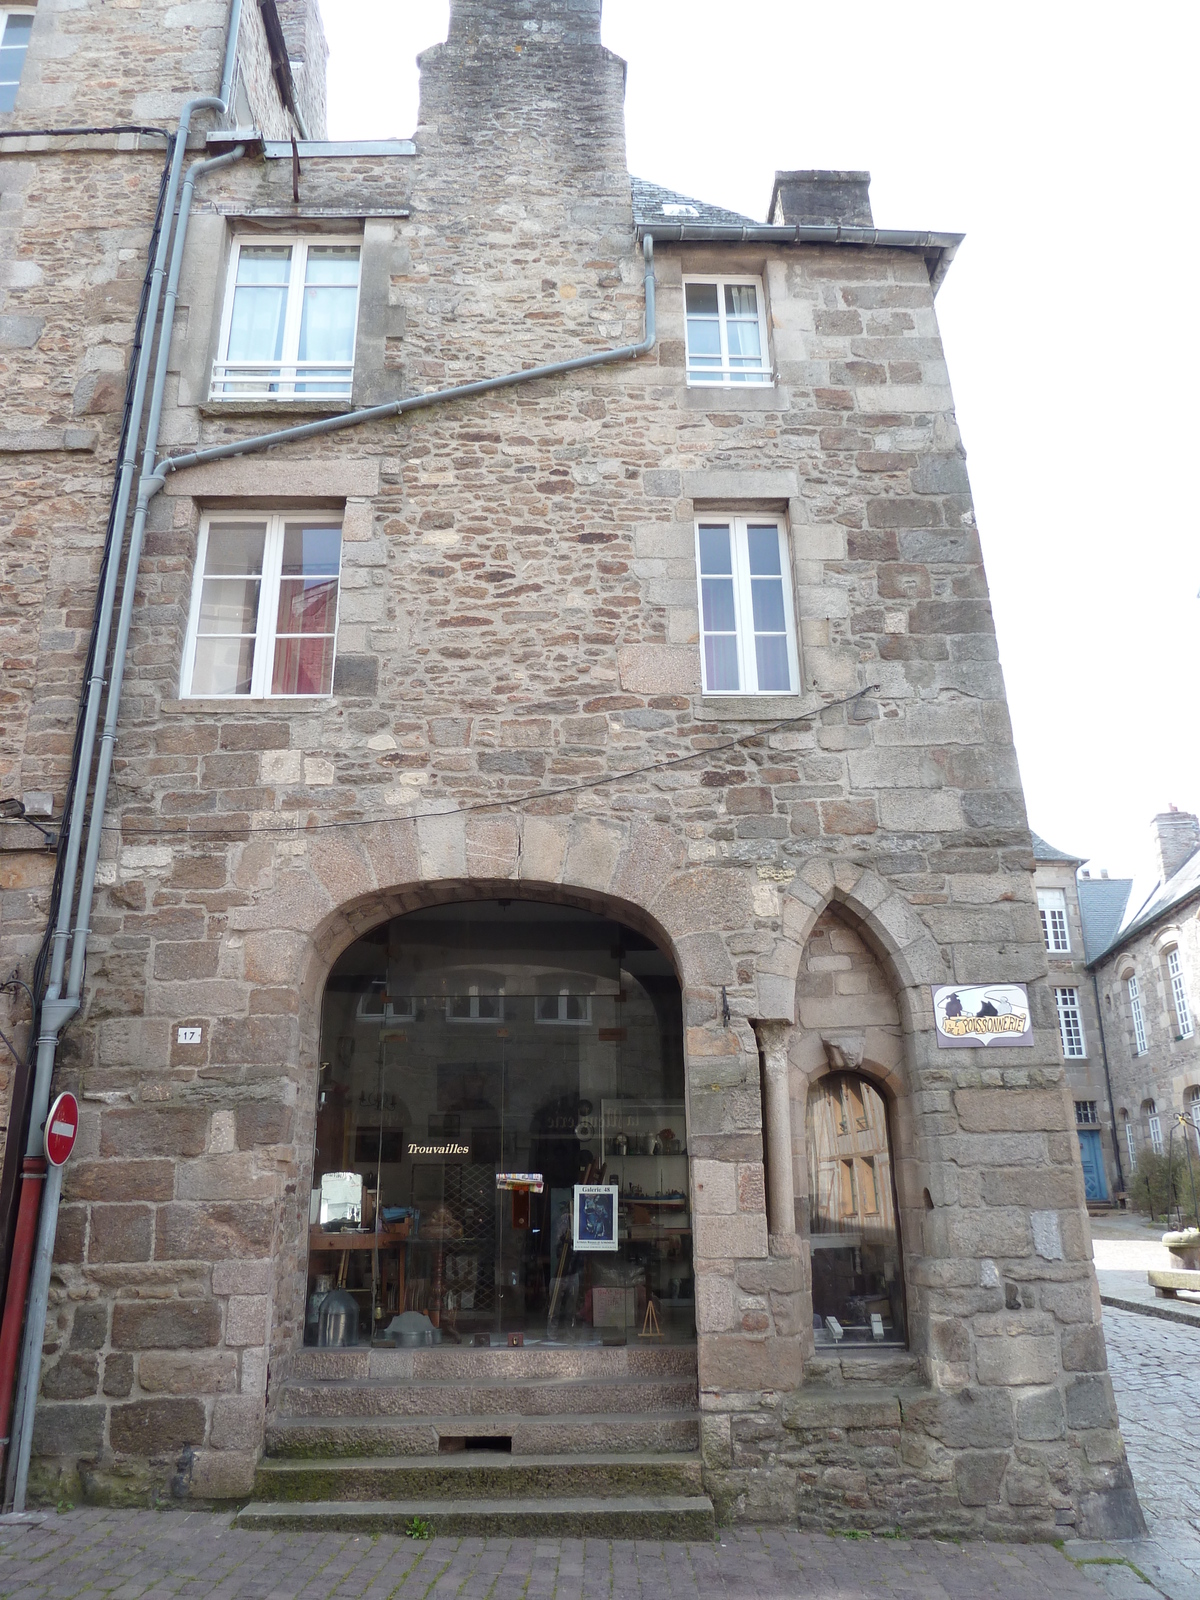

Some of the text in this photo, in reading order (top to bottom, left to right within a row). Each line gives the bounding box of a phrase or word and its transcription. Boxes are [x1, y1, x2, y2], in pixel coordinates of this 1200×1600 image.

[963, 1016, 1024, 1033] POISSONNERIE
[184, 1032, 195, 1040] 17
[407, 1143, 469, 1154] Trouvailles
